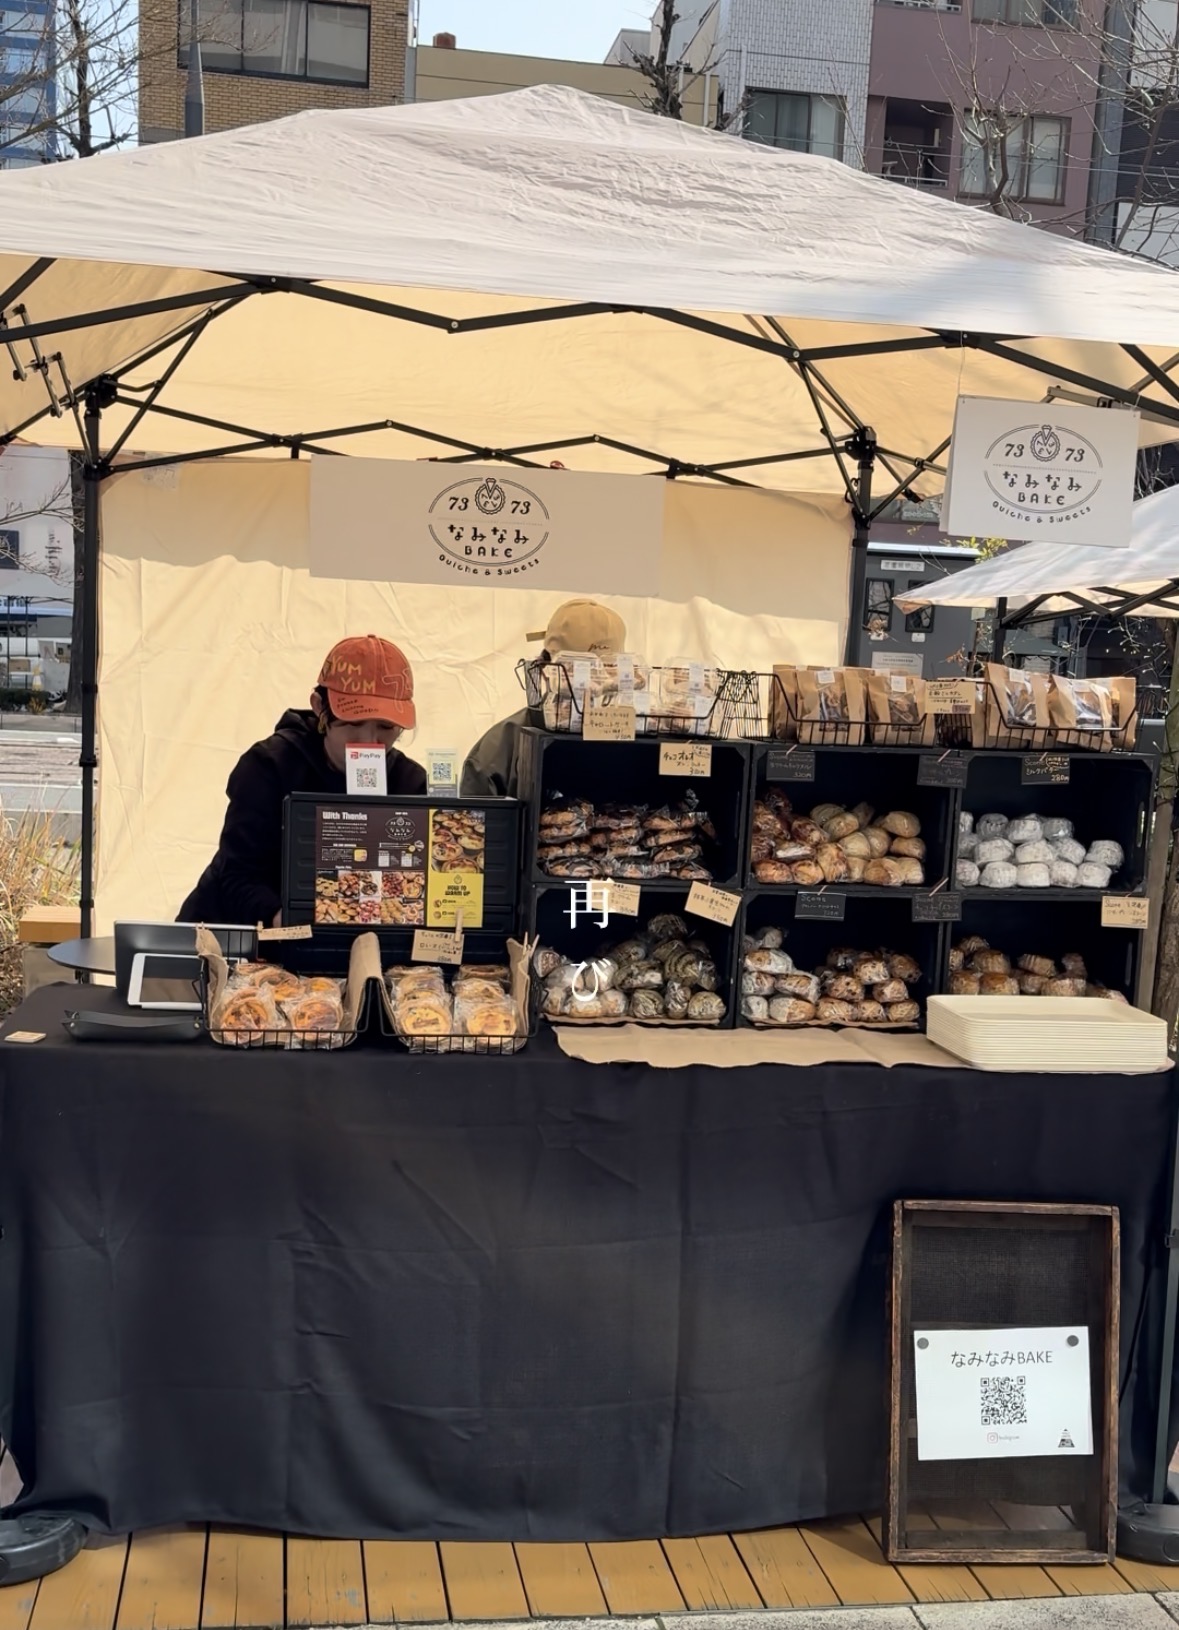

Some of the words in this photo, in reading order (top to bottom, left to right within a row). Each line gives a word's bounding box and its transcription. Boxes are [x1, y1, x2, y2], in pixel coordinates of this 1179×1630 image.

[1004, 443, 1025, 458] 73
[1064, 448, 1086, 462] 73
[1003, 471, 1082, 492] なみなみ
[449, 496, 469, 511] 73
[511, 500, 531, 515] 73
[1018, 491, 1065, 506] BAKE
[448, 524, 529, 544] なみなみ
[464, 545, 513, 558] BAKE
[497, 558, 539, 576] Sweets
[330, 655, 362, 676] YUM
[340, 677, 376, 695] YUM
[322, 811, 341, 820] With
[342, 811, 368, 821] Thanks
[950, 1350, 1053, 1368] なみなみBAKE
